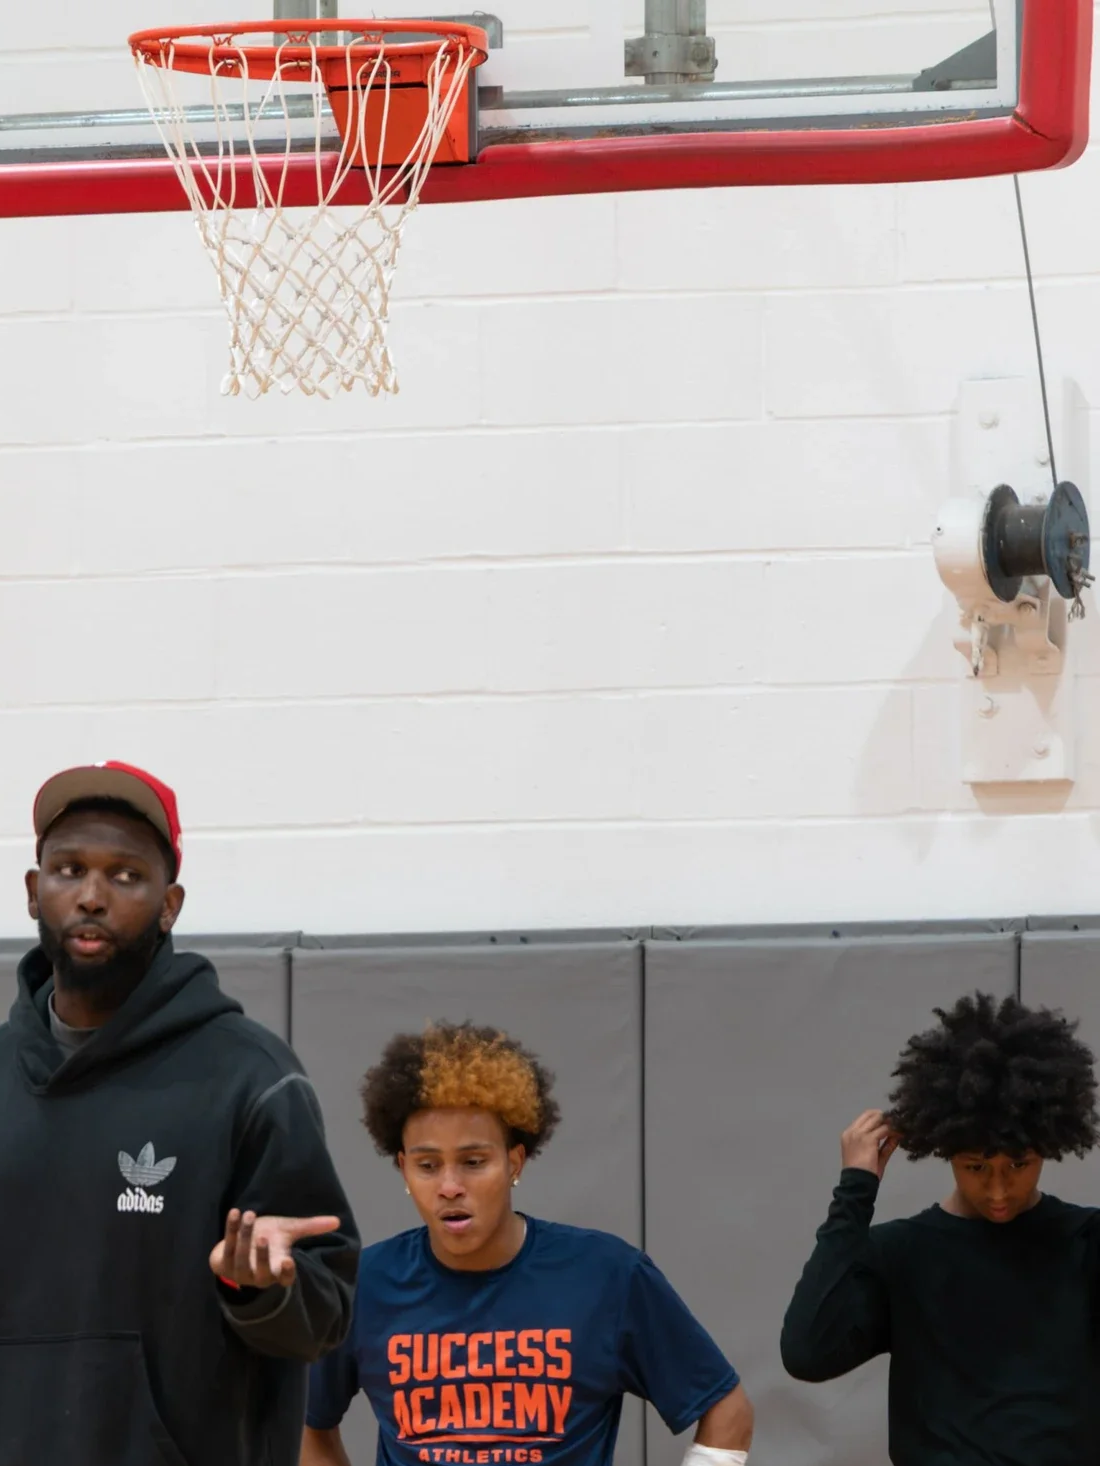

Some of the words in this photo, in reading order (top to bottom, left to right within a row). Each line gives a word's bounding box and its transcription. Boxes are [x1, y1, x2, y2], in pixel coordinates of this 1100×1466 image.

[117, 1186, 165, 1214] adidas
[387, 1328, 573, 1386] SUCCESS
[393, 1382, 573, 1440] ACADEMY
[418, 1448, 544, 1465] ATHLETICS
